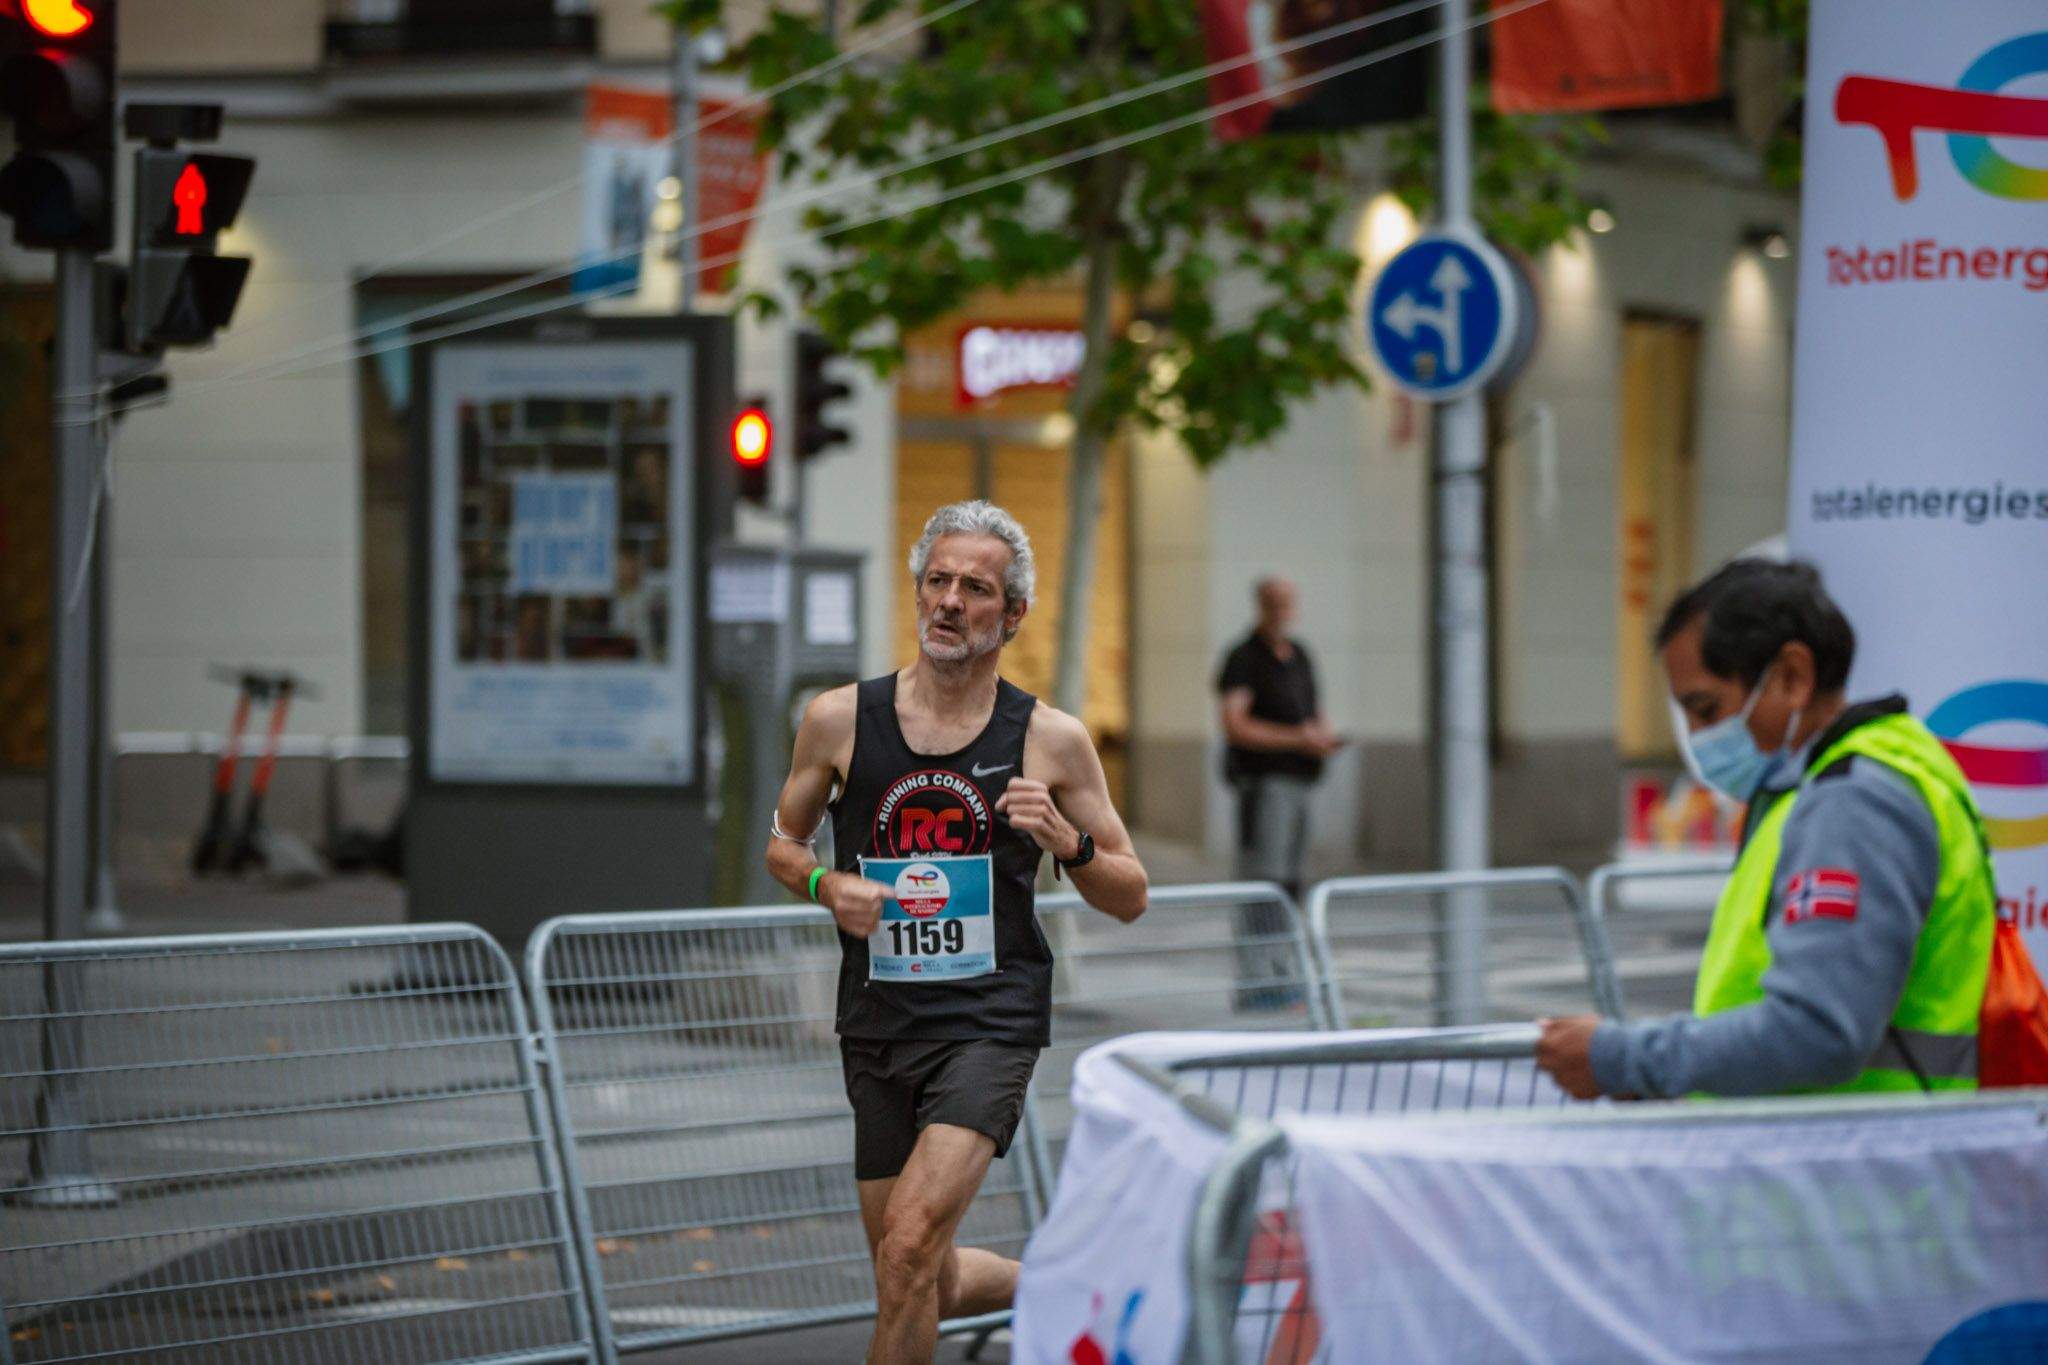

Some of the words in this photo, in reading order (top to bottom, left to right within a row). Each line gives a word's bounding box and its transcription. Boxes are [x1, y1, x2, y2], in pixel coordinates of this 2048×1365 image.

[879, 774, 928, 823] RUNNING
[932, 773, 987, 821] COMPANY
[900, 808, 963, 851] RC
[887, 919, 964, 955] 1159
